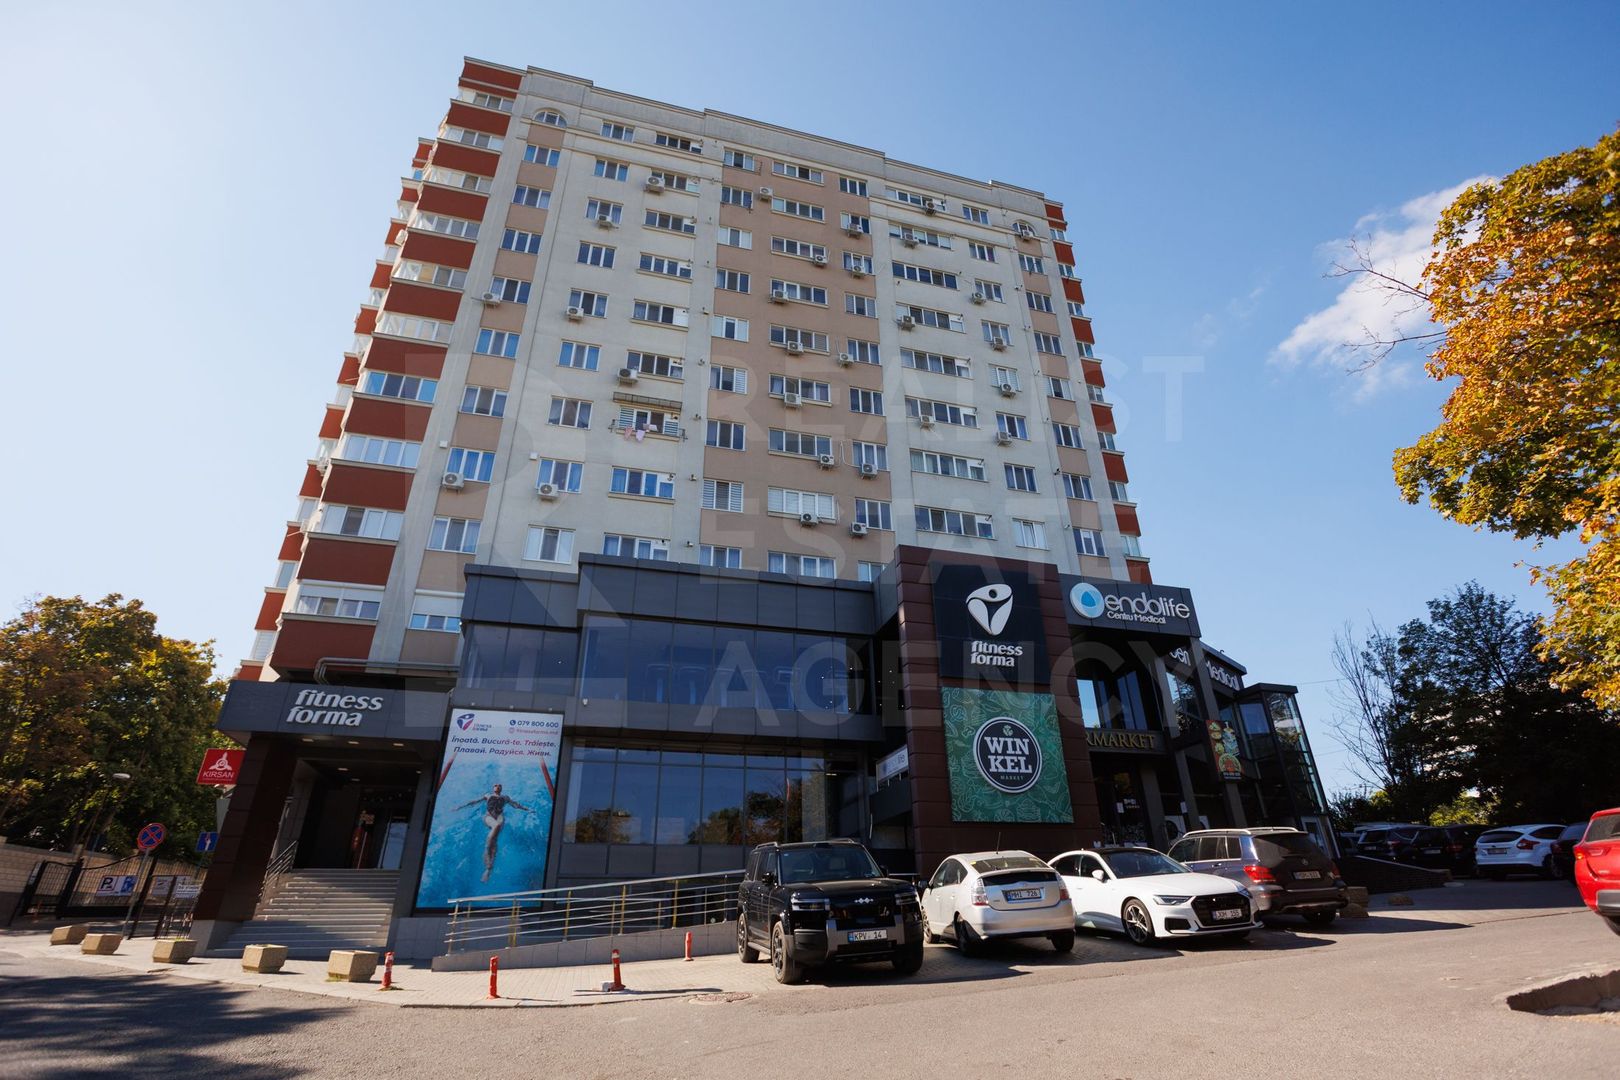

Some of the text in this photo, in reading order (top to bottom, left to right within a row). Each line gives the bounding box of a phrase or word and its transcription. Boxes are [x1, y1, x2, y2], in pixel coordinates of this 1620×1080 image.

[1104, 591, 1191, 619] endolife
[1106, 610, 1167, 624] Centru Medical
[971, 640, 1023, 656] fitness
[970, 651, 1015, 667] forma
[294, 689, 384, 711] fitness
[286, 706, 363, 727] forma
[481, 737, 522, 746] Bucură-te.
[984, 736, 1030, 755] WIN
[453, 746, 487, 754] Плавай.
[489, 747, 525, 756] Радуйся.
[988, 755, 1033, 773] KEL
